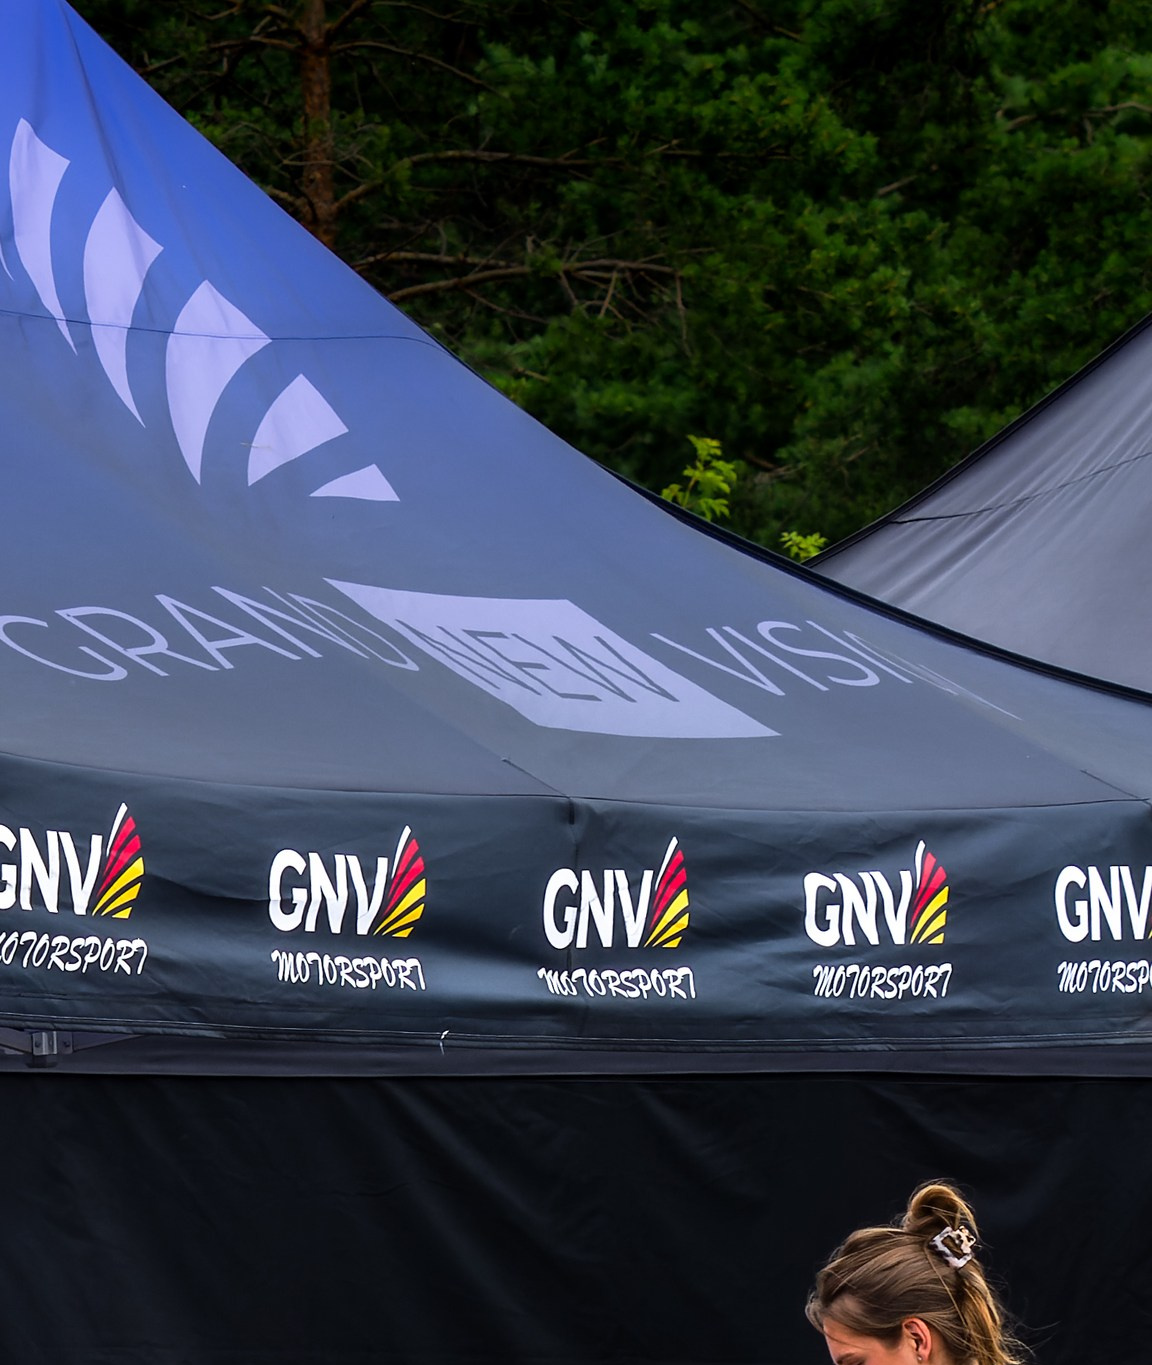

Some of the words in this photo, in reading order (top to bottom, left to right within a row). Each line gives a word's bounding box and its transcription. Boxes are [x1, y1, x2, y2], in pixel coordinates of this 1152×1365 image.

[395, 619, 680, 703] NEW
[649, 619, 1023, 721] VISI
[269, 849, 389, 936] GNV
[543, 868, 654, 949] GNV
[804, 871, 913, 947] GNV
[1055, 865, 1152, 943] GNV
[271, 949, 427, 991] MOTORSPORT
[537, 966, 697, 1000] MOTORSPORT
[813, 962, 953, 1000] MOTORSPORT
[1057, 959, 1152, 994] MOTORSP
